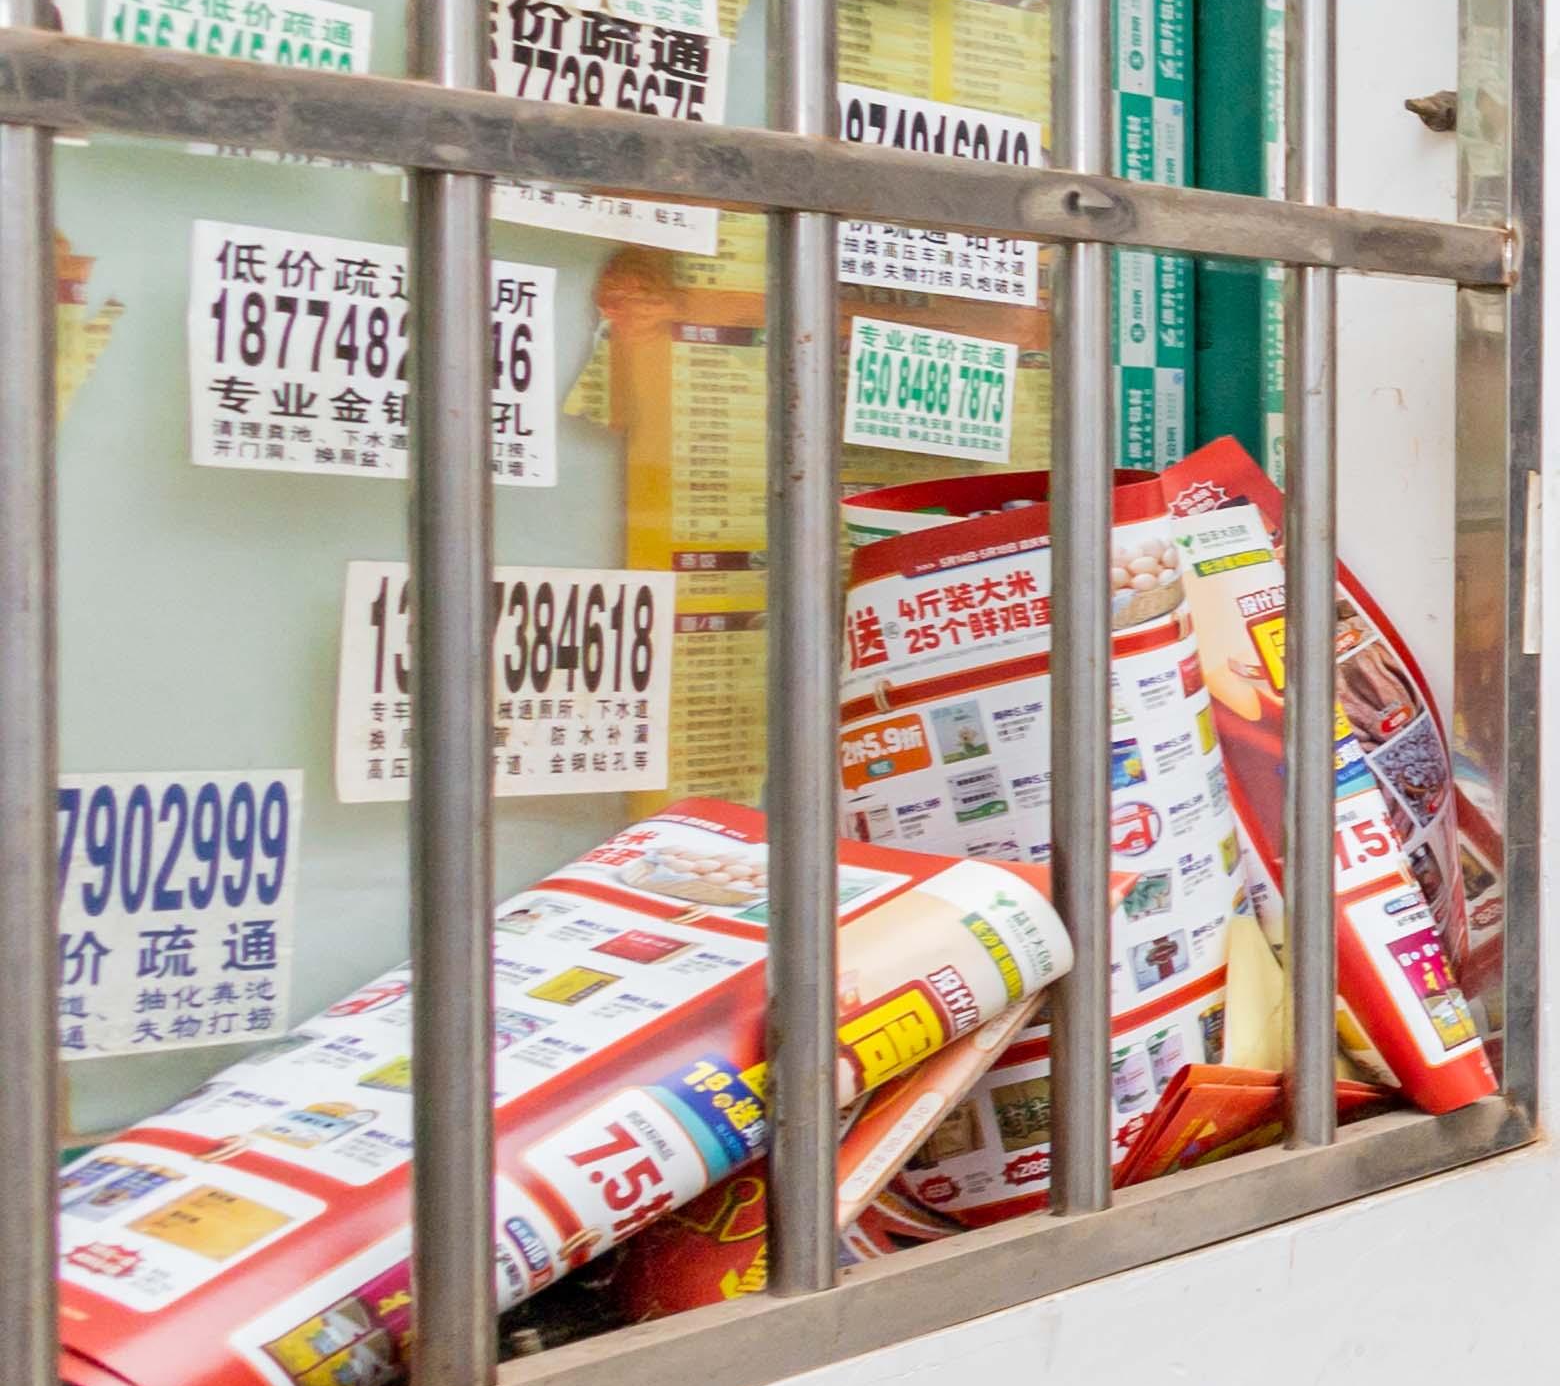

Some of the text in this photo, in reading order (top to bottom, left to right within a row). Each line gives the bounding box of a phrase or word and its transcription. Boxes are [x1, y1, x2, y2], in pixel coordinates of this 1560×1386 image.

[857, 324, 1006, 370] 专业低价疏通
[855, 348, 1005, 424] 150 8488 7873
[896, 569, 1038, 623] 4斤装大米
